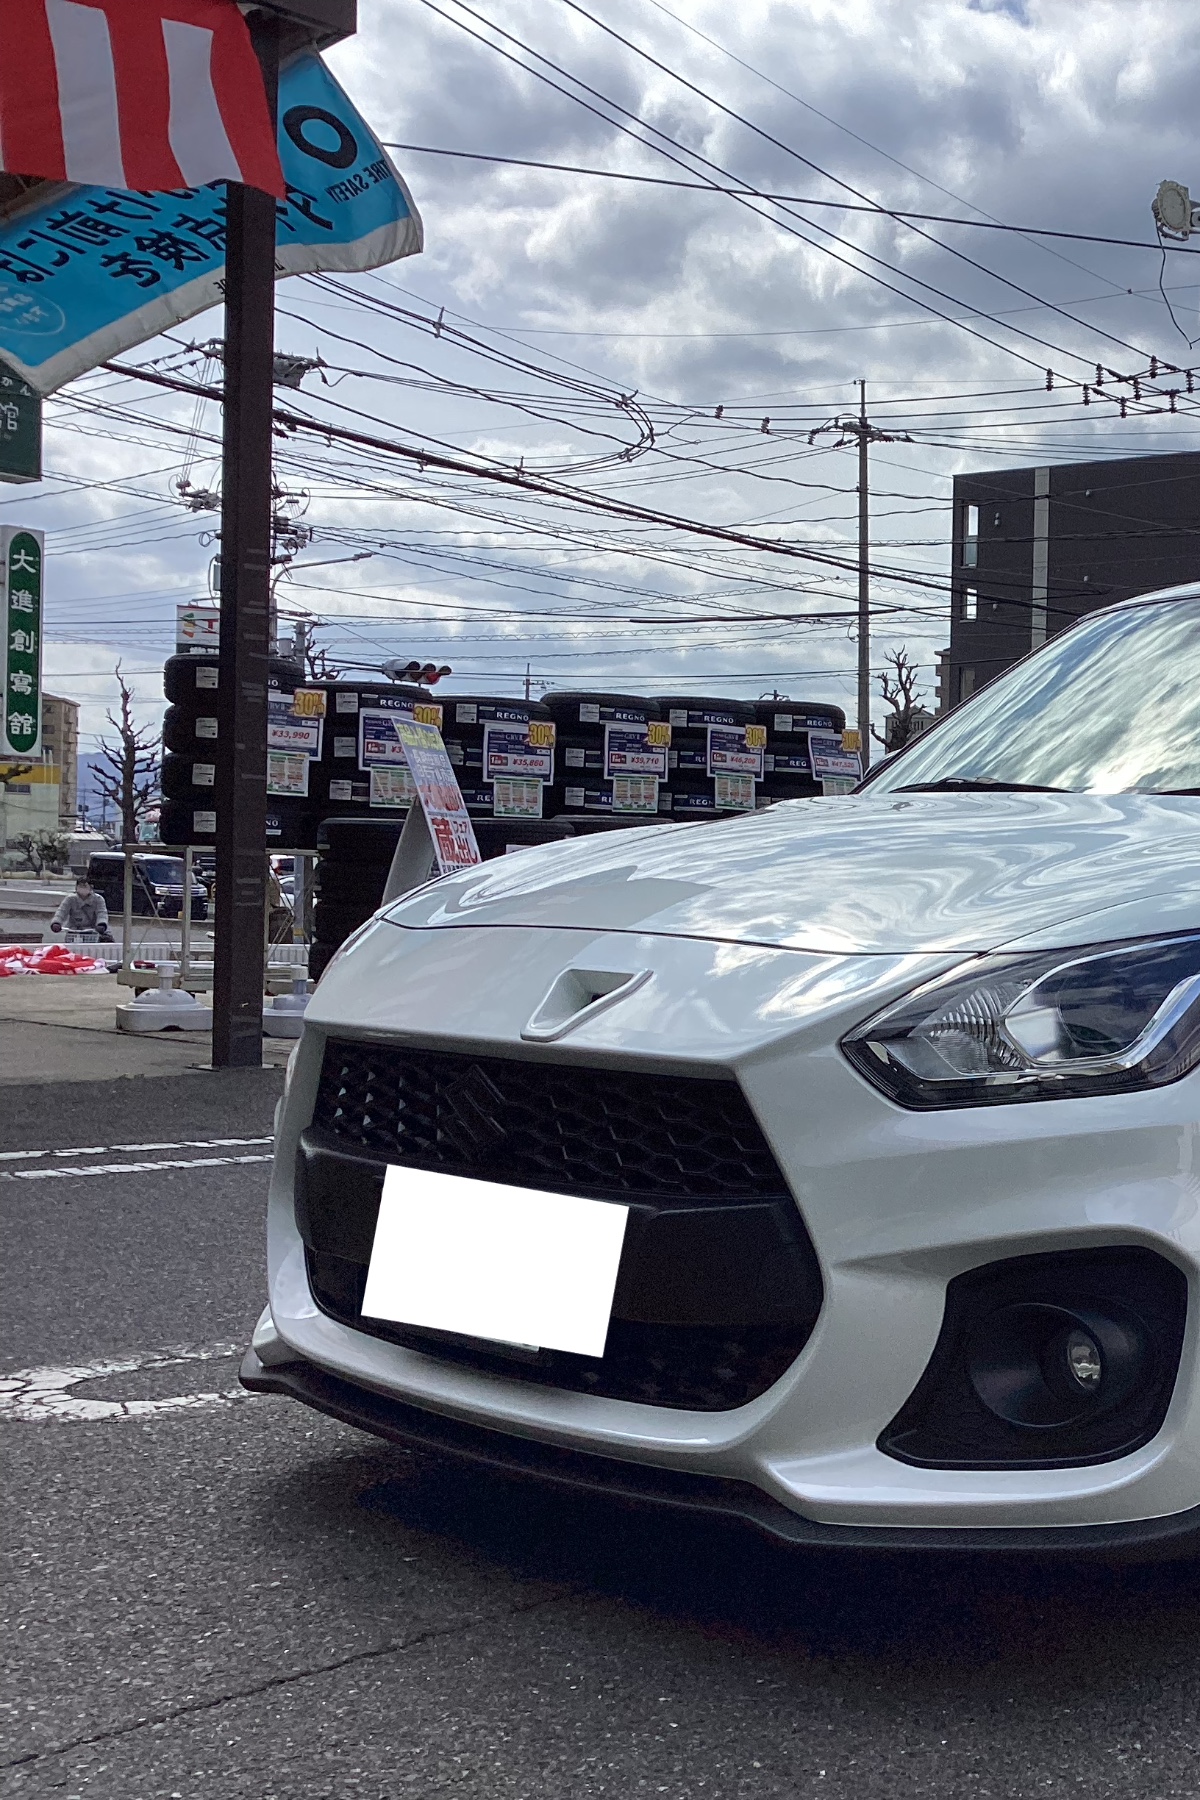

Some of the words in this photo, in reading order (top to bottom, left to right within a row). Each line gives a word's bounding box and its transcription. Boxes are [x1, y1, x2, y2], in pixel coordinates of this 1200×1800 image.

[380, 699, 413, 708] REGNO
[496, 711, 529, 721] REGNO
[615, 712, 645, 721] REGNO
[703, 715, 734, 724] REGNO
[806, 719, 833, 727] REGNO
[272, 729, 310, 740] ¥33,990
[689, 798, 714, 806] REGN
